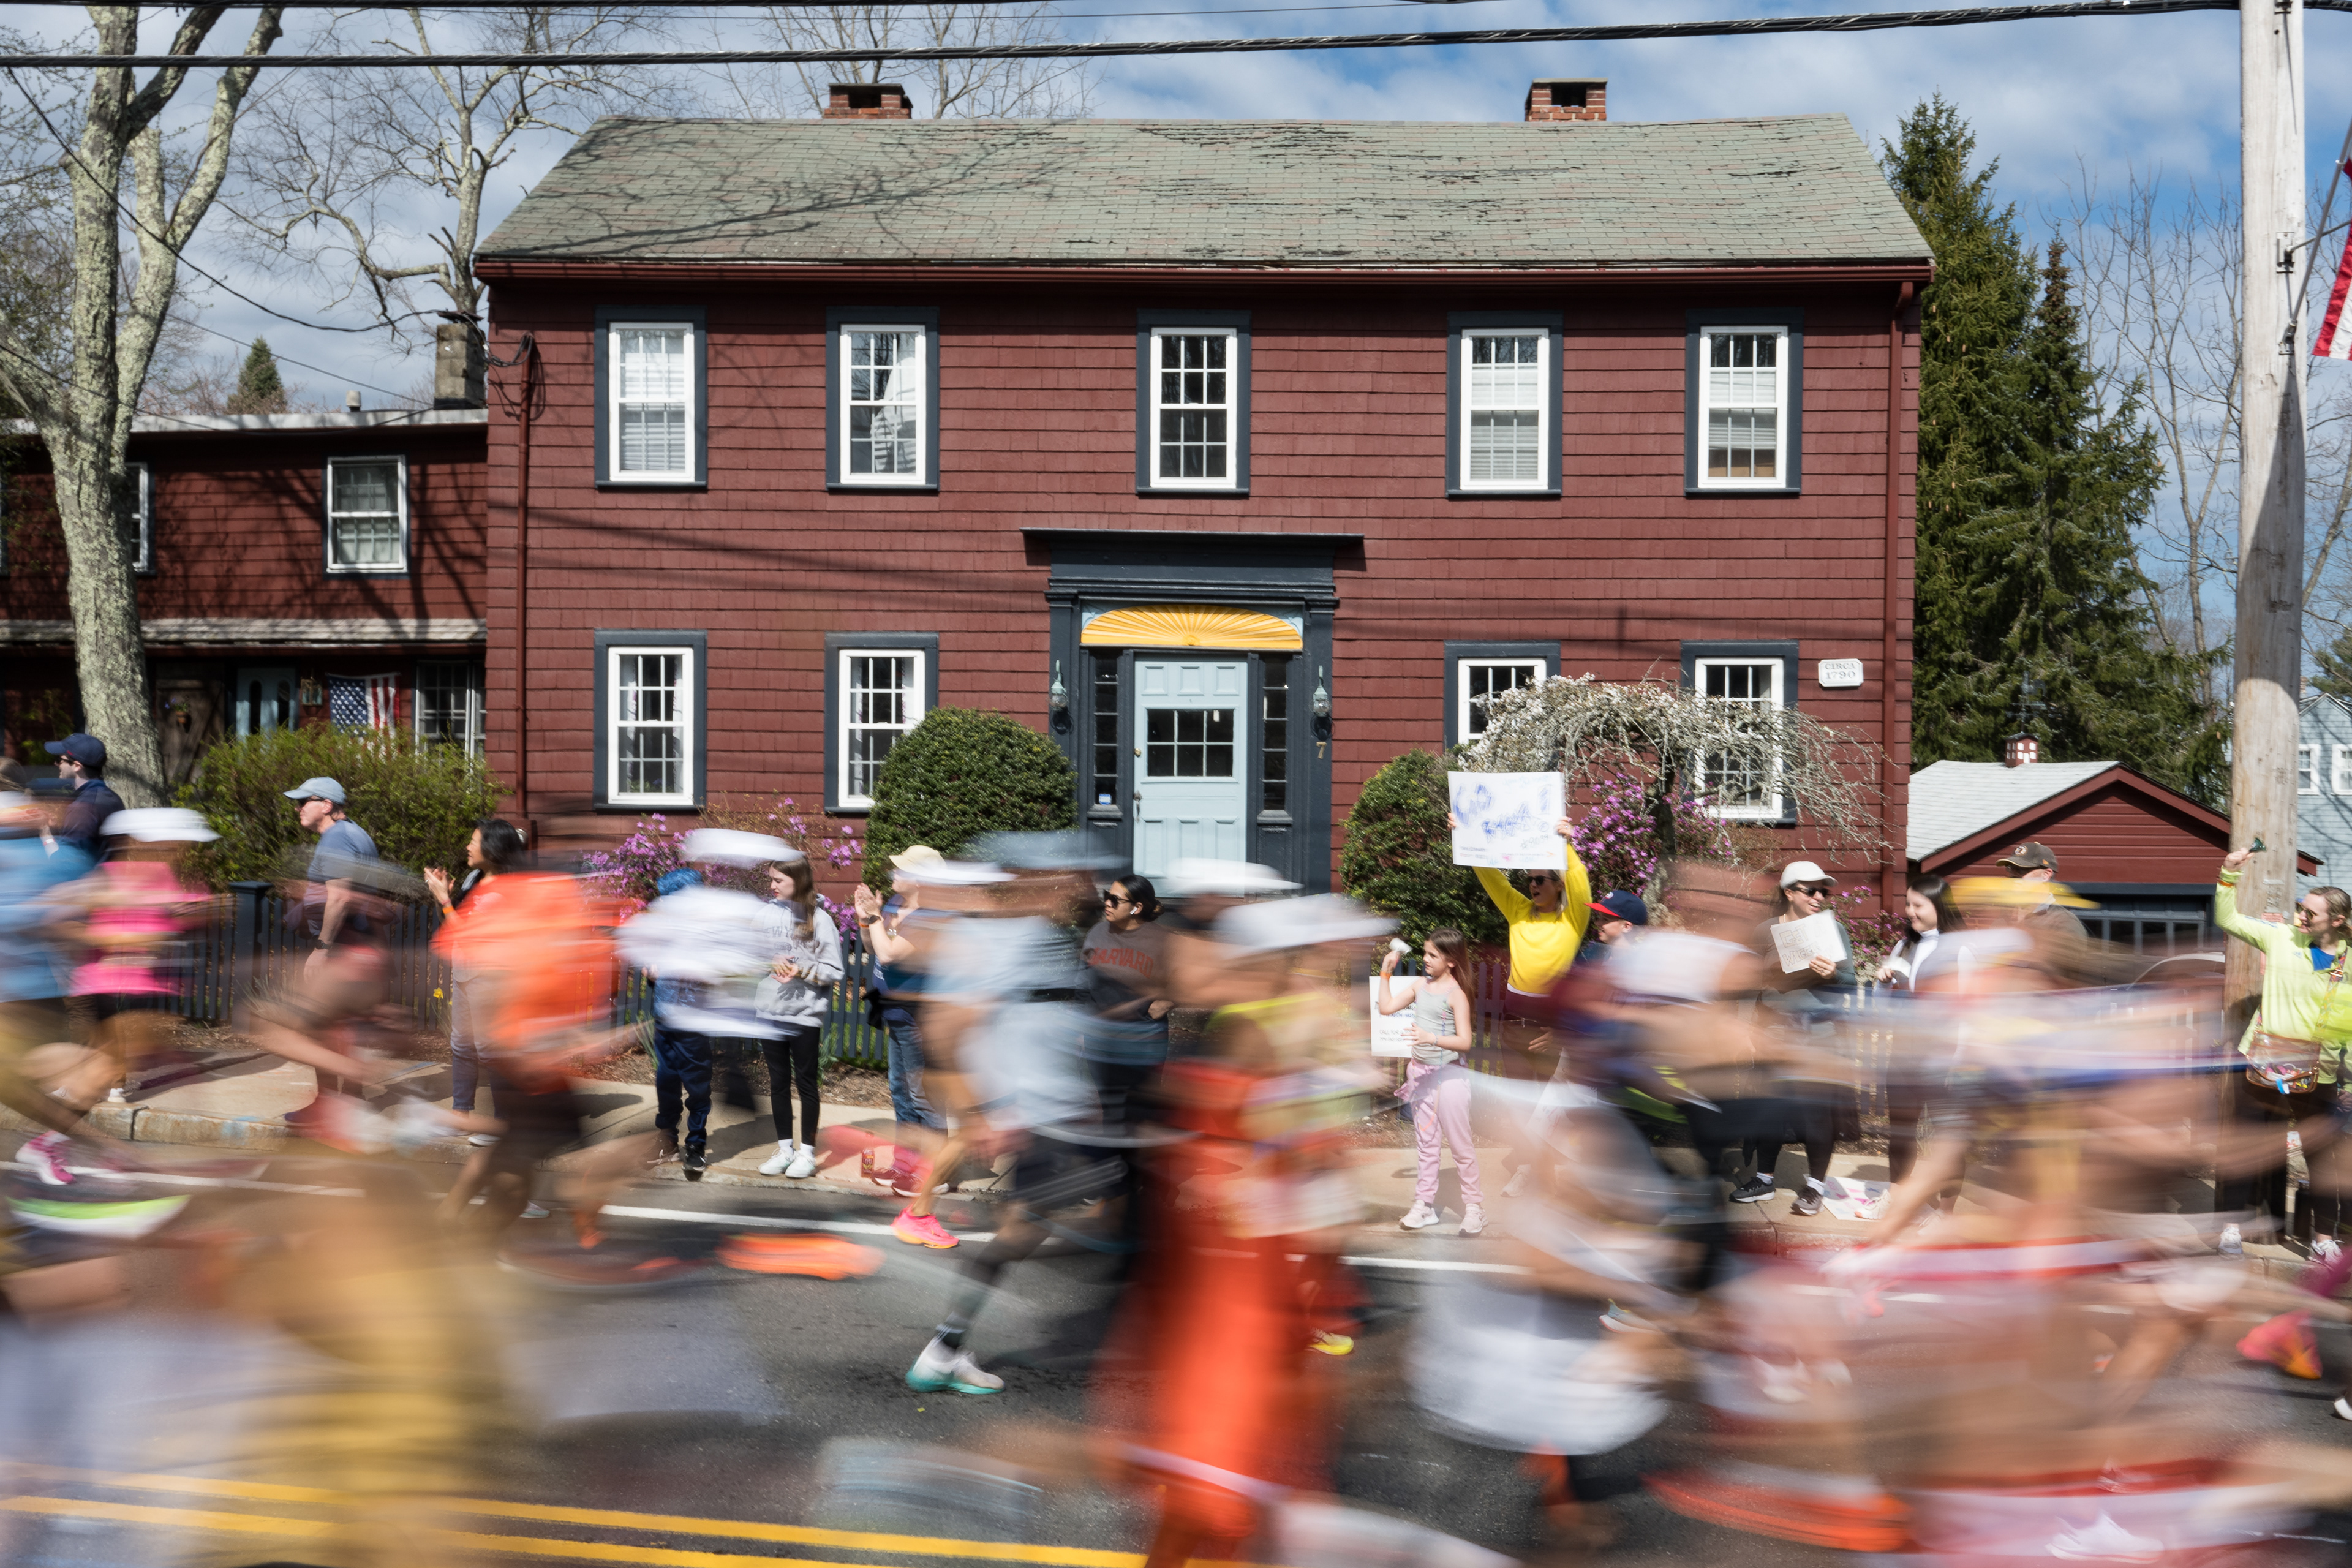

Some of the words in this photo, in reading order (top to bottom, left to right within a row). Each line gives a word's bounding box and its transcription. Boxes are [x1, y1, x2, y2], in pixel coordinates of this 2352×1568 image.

[1825, 671, 1856, 679] 1790
[1316, 741, 1327, 760] 7
[1779, 923, 1809, 948] GET
